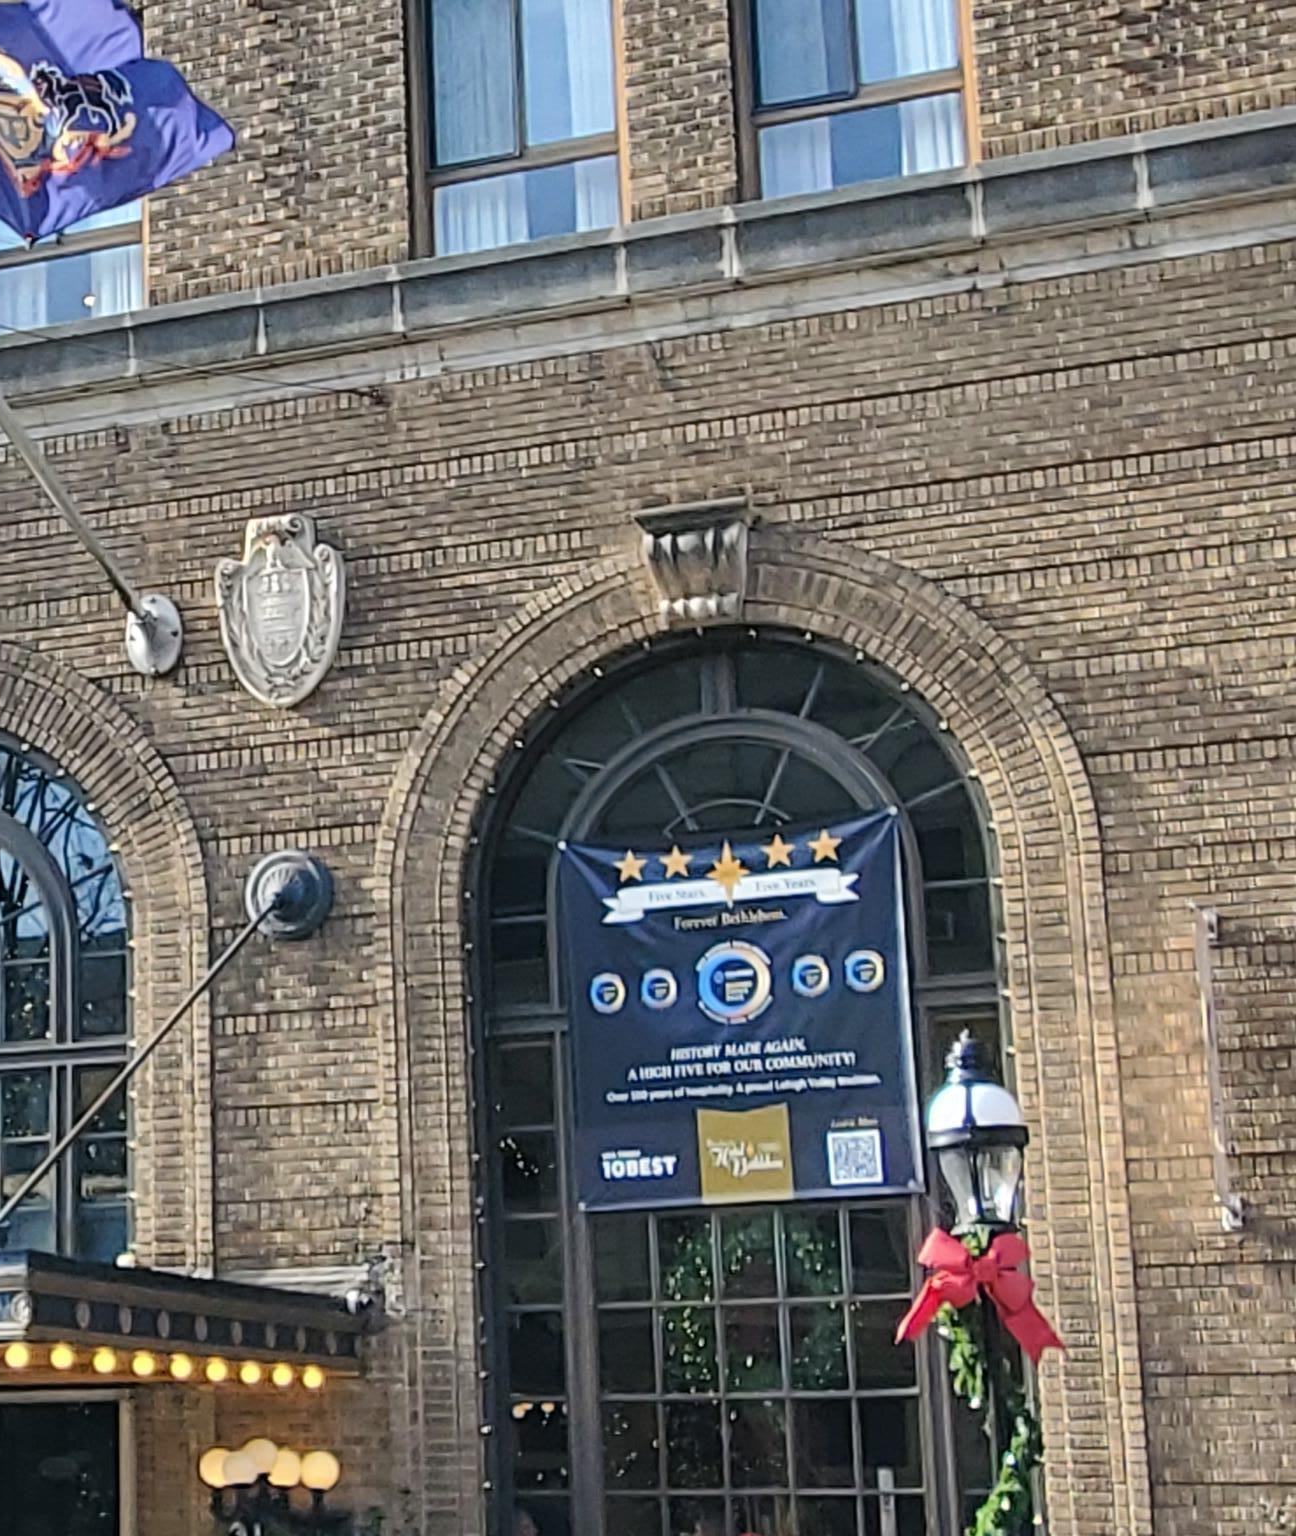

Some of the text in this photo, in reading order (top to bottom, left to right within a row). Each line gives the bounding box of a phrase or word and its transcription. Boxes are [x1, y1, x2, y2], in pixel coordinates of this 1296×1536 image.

[673, 914, 719, 931] Forever
[670, 1045, 722, 1062] HISTORY
[724, 1041, 762, 1057] MADE
[627, 1068, 638, 1081] A
[639, 1066, 672, 1080] HIGH
[674, 1063, 704, 1078] FIVE
[706, 1061, 732, 1076] FOR
[735, 1059, 763, 1074] OUR
[602, 1155, 677, 1180] 10BEST
